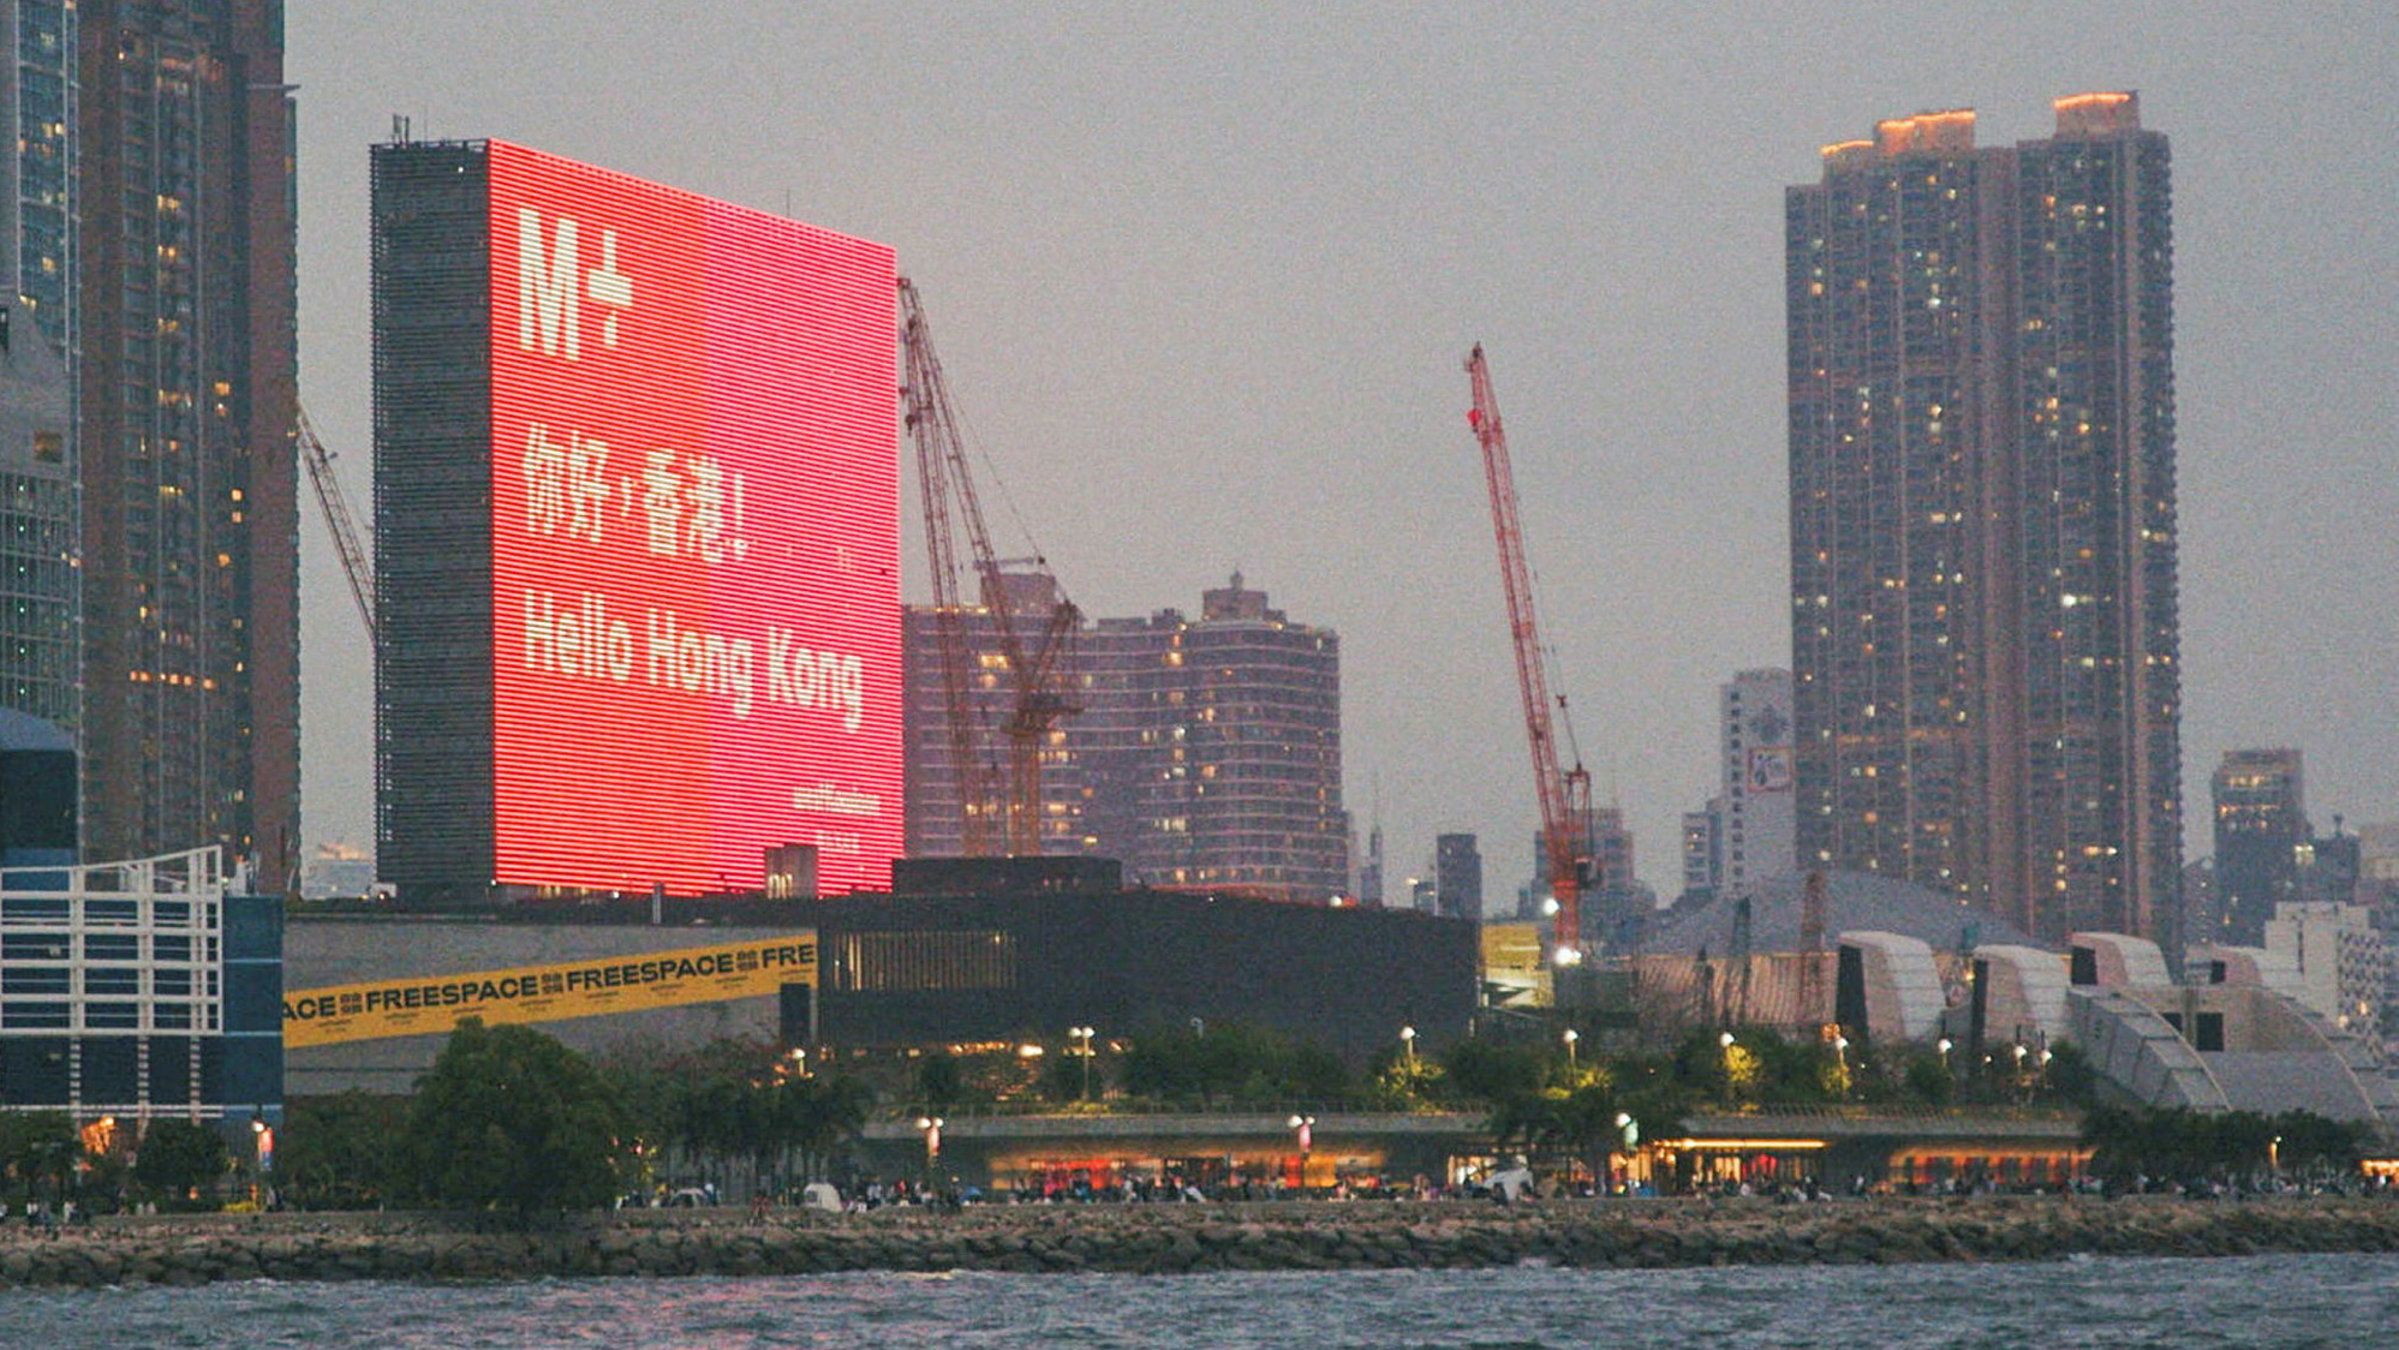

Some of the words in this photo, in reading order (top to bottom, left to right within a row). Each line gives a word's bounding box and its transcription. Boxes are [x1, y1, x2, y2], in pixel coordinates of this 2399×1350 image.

[519, 207, 633, 361] M+
[525, 588, 632, 682] Hello
[648, 607, 752, 720] Hong
[768, 625, 863, 734] Kong
[366, 975, 539, 1012] FREESPACE
[566, 953, 734, 991] FREESPACE
[762, 944, 815, 968] FRE
